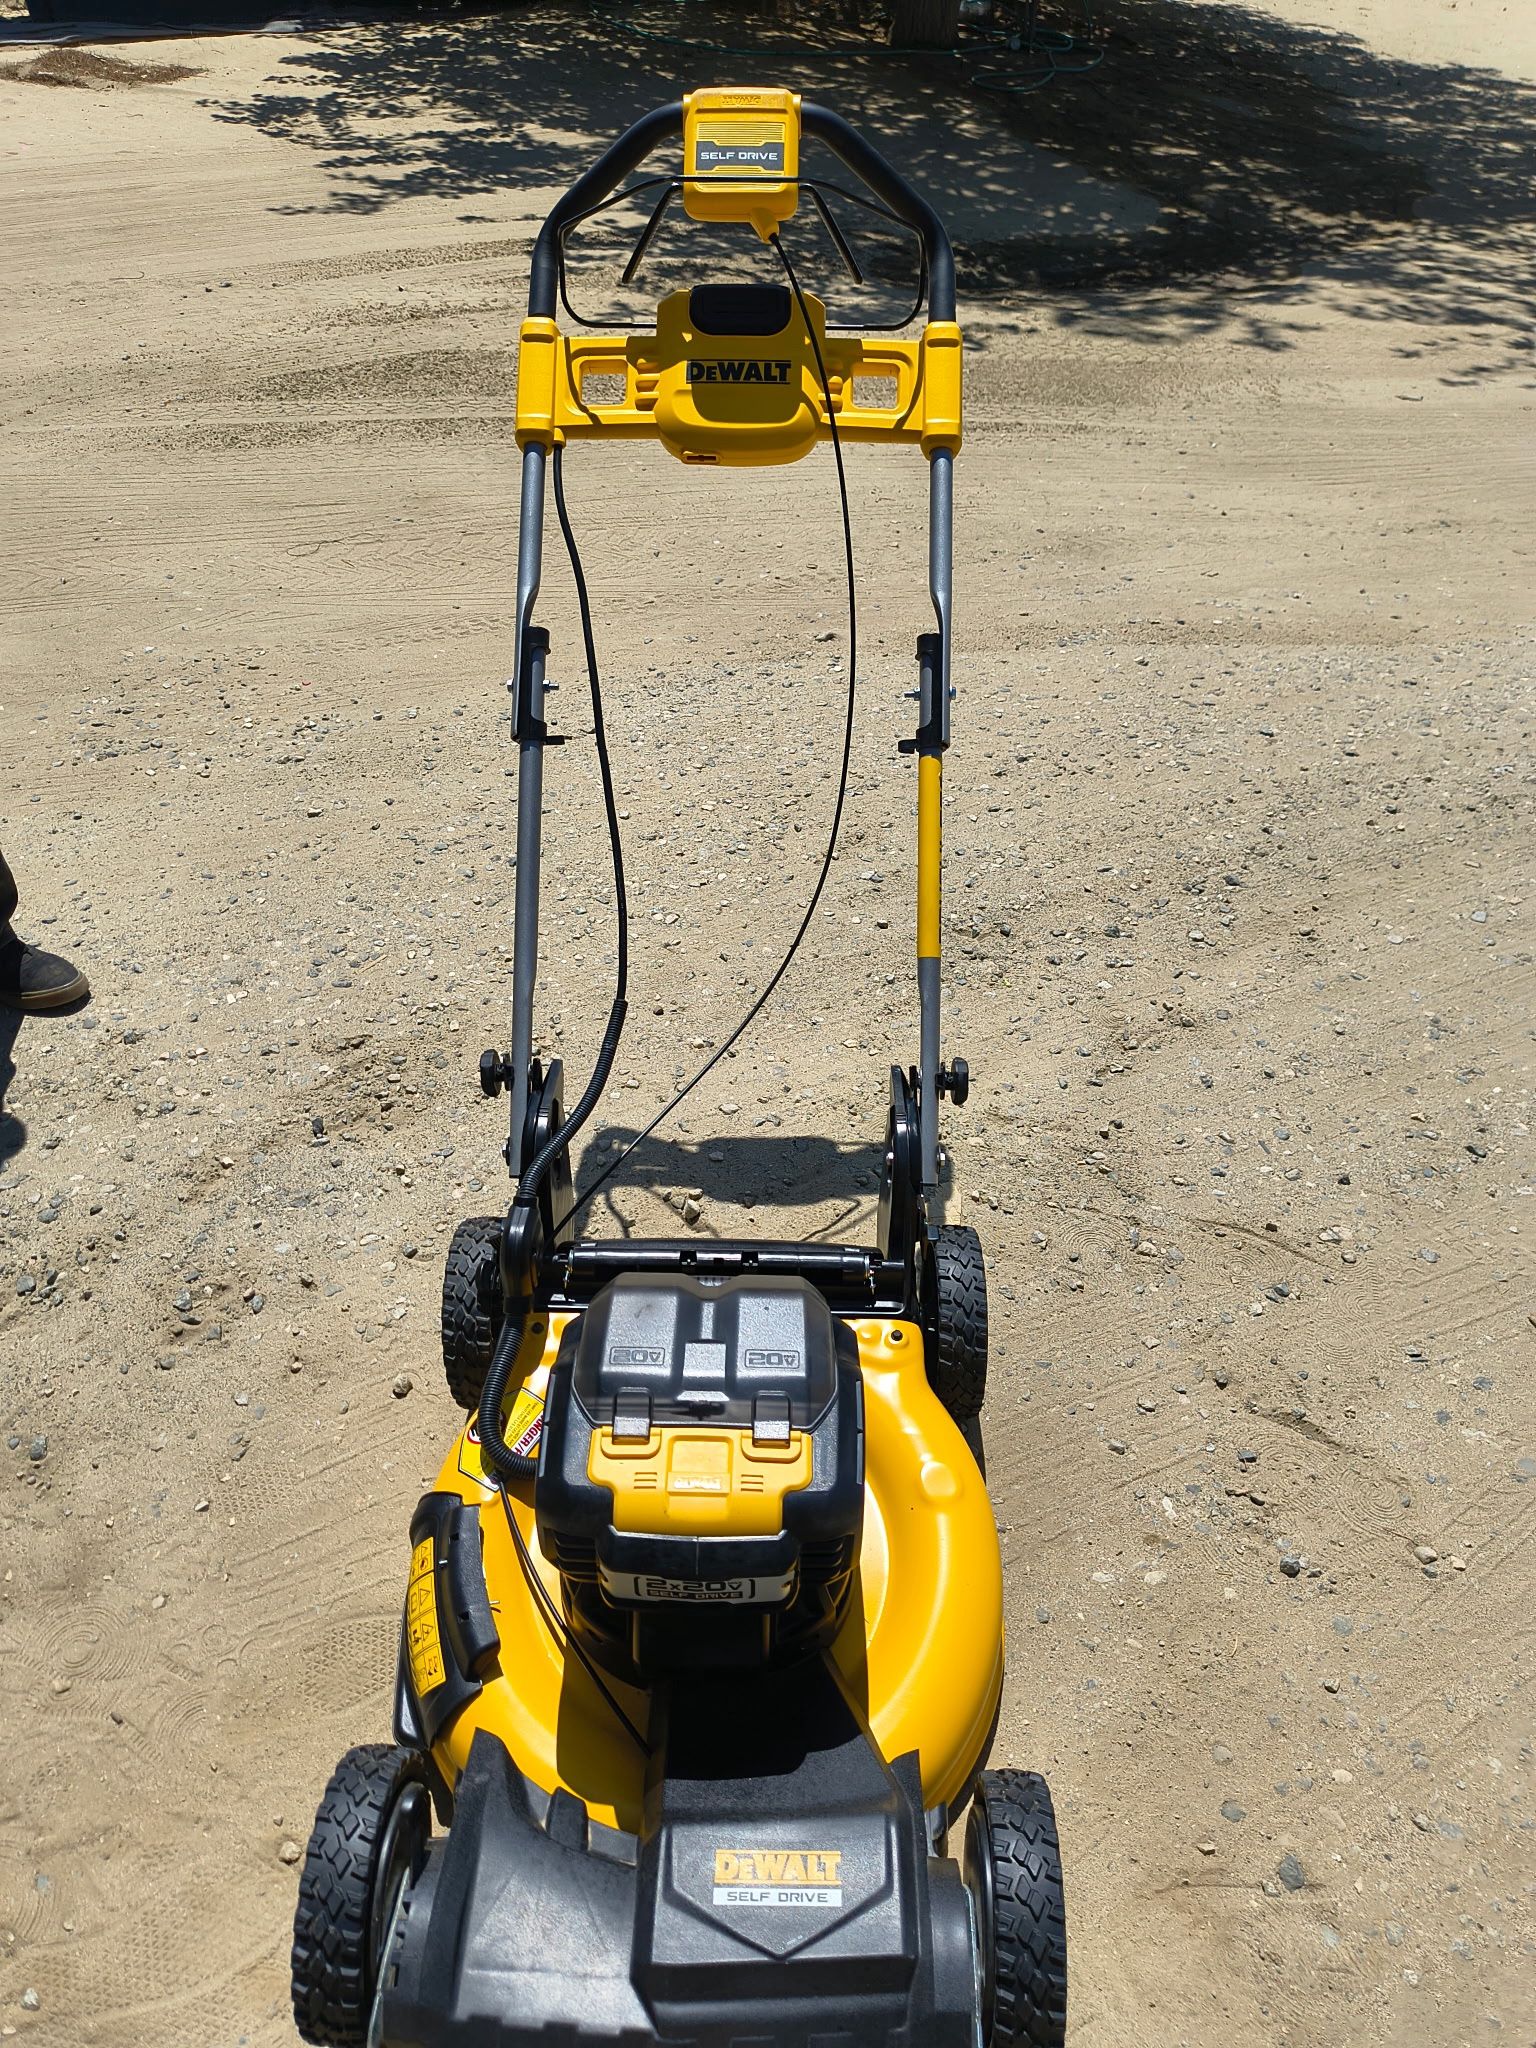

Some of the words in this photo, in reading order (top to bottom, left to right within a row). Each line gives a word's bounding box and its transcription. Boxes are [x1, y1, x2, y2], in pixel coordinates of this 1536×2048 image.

[700, 151, 735, 160] SELF
[738, 151, 778, 161] DRIVE
[648, 1589, 689, 1598] SELF
[694, 1592, 741, 1600] DRIVE
[727, 1891, 771, 1902] SELF
[778, 1892, 828, 1903] DRIVE
